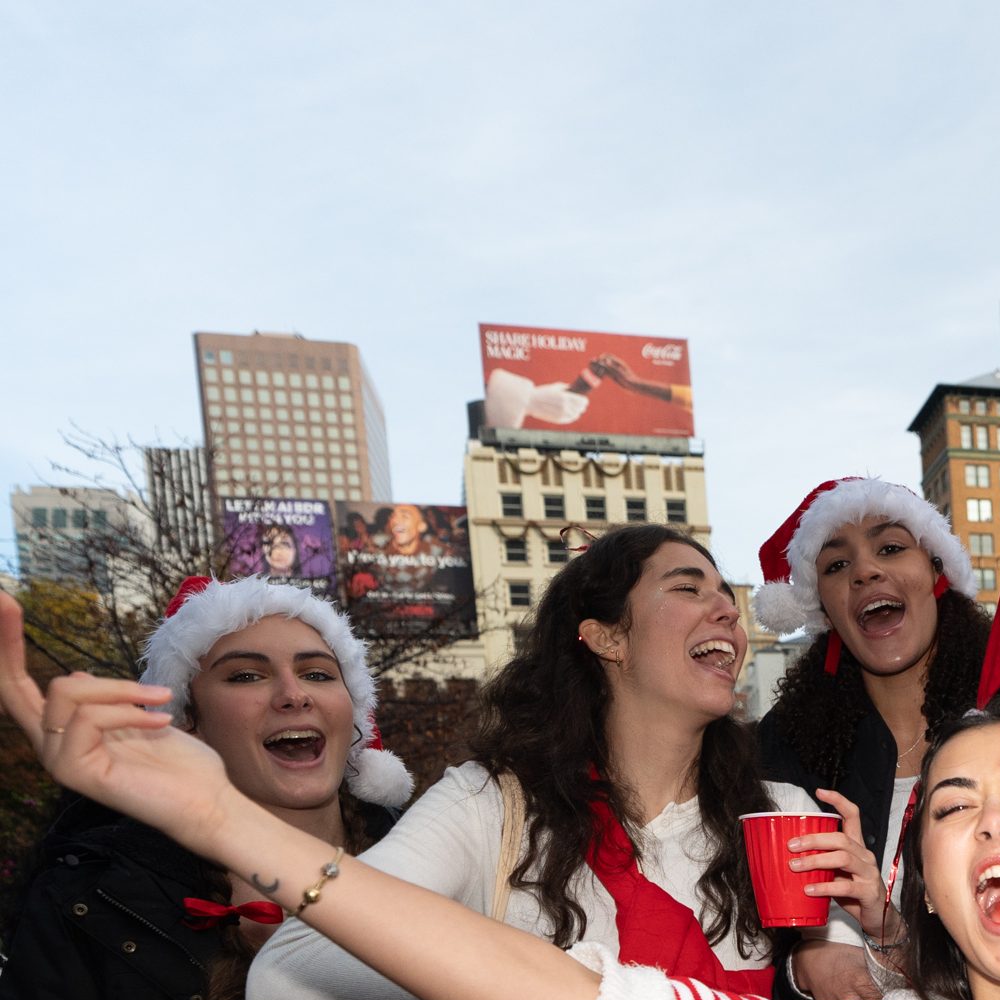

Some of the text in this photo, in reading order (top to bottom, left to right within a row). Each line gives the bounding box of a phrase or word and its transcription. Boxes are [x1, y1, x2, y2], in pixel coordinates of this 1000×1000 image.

[485, 329, 586, 352] SHARE HOLIDAY
[486, 345, 530, 361] MAGIC
[225, 498, 253, 513] LET
